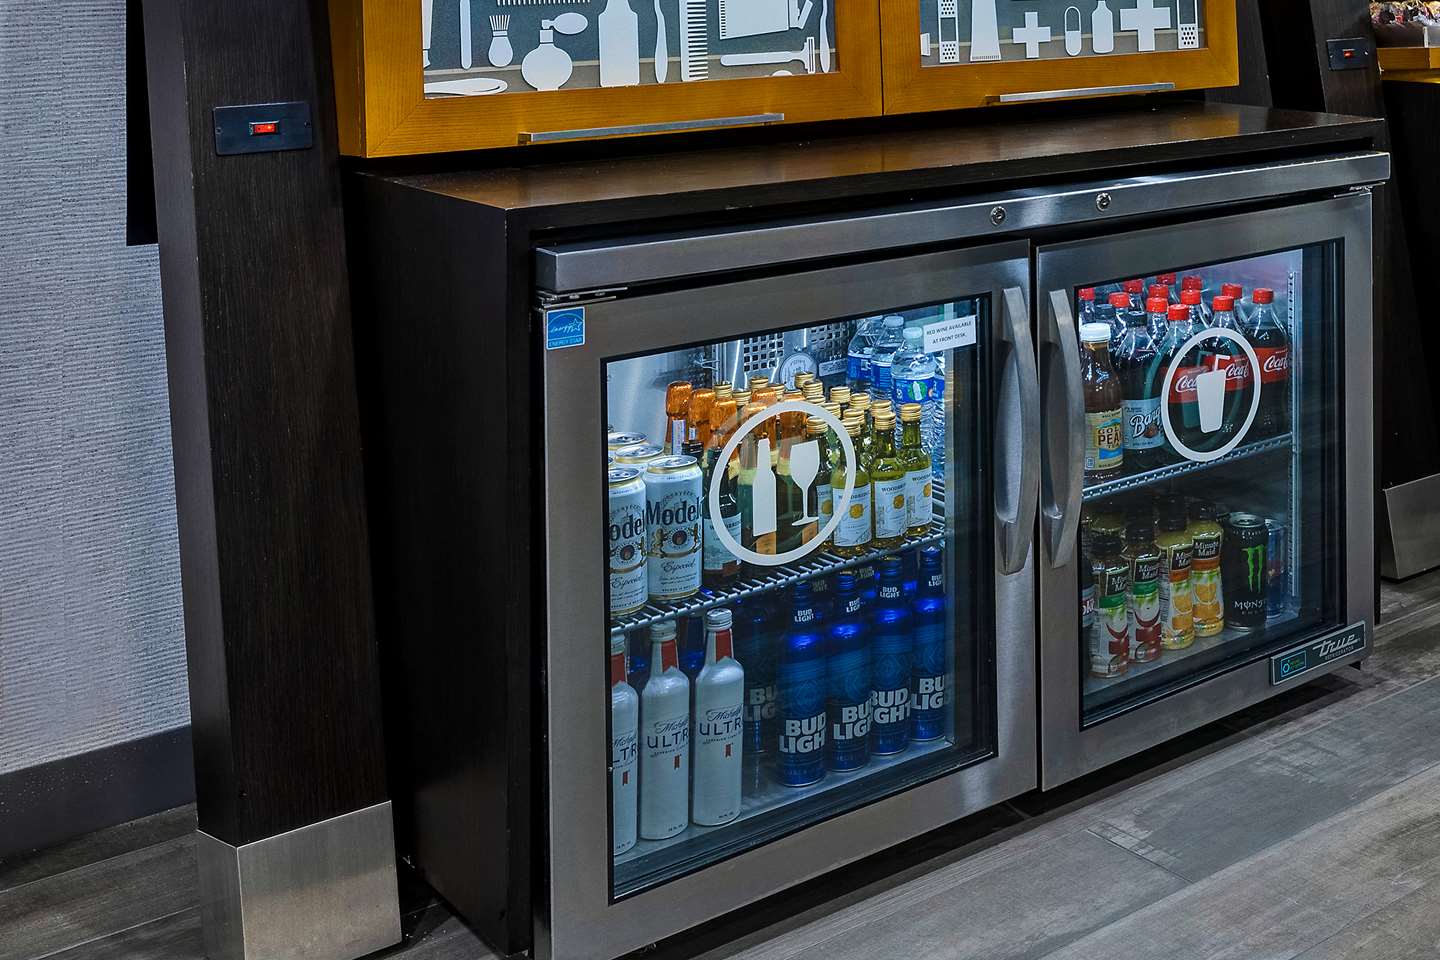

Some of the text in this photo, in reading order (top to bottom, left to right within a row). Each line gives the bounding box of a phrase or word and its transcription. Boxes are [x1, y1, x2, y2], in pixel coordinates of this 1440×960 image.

[1097, 431, 1121, 446] PEA
[647, 496, 702, 526] Model
[609, 510, 646, 541] odel
[879, 591, 900, 599] LIGHT
[794, 614, 815, 623] LIGHT
[797, 608, 813, 617] BUD
[919, 674, 945, 694] BU
[750, 685, 777, 705] BU
[911, 691, 944, 710] LIG
[842, 697, 872, 724] BU
[699, 717, 743, 736] ULTR
[785, 712, 827, 737] BUD
[647, 727, 688, 749] ULTR
[779, 728, 826, 753] LIGH
